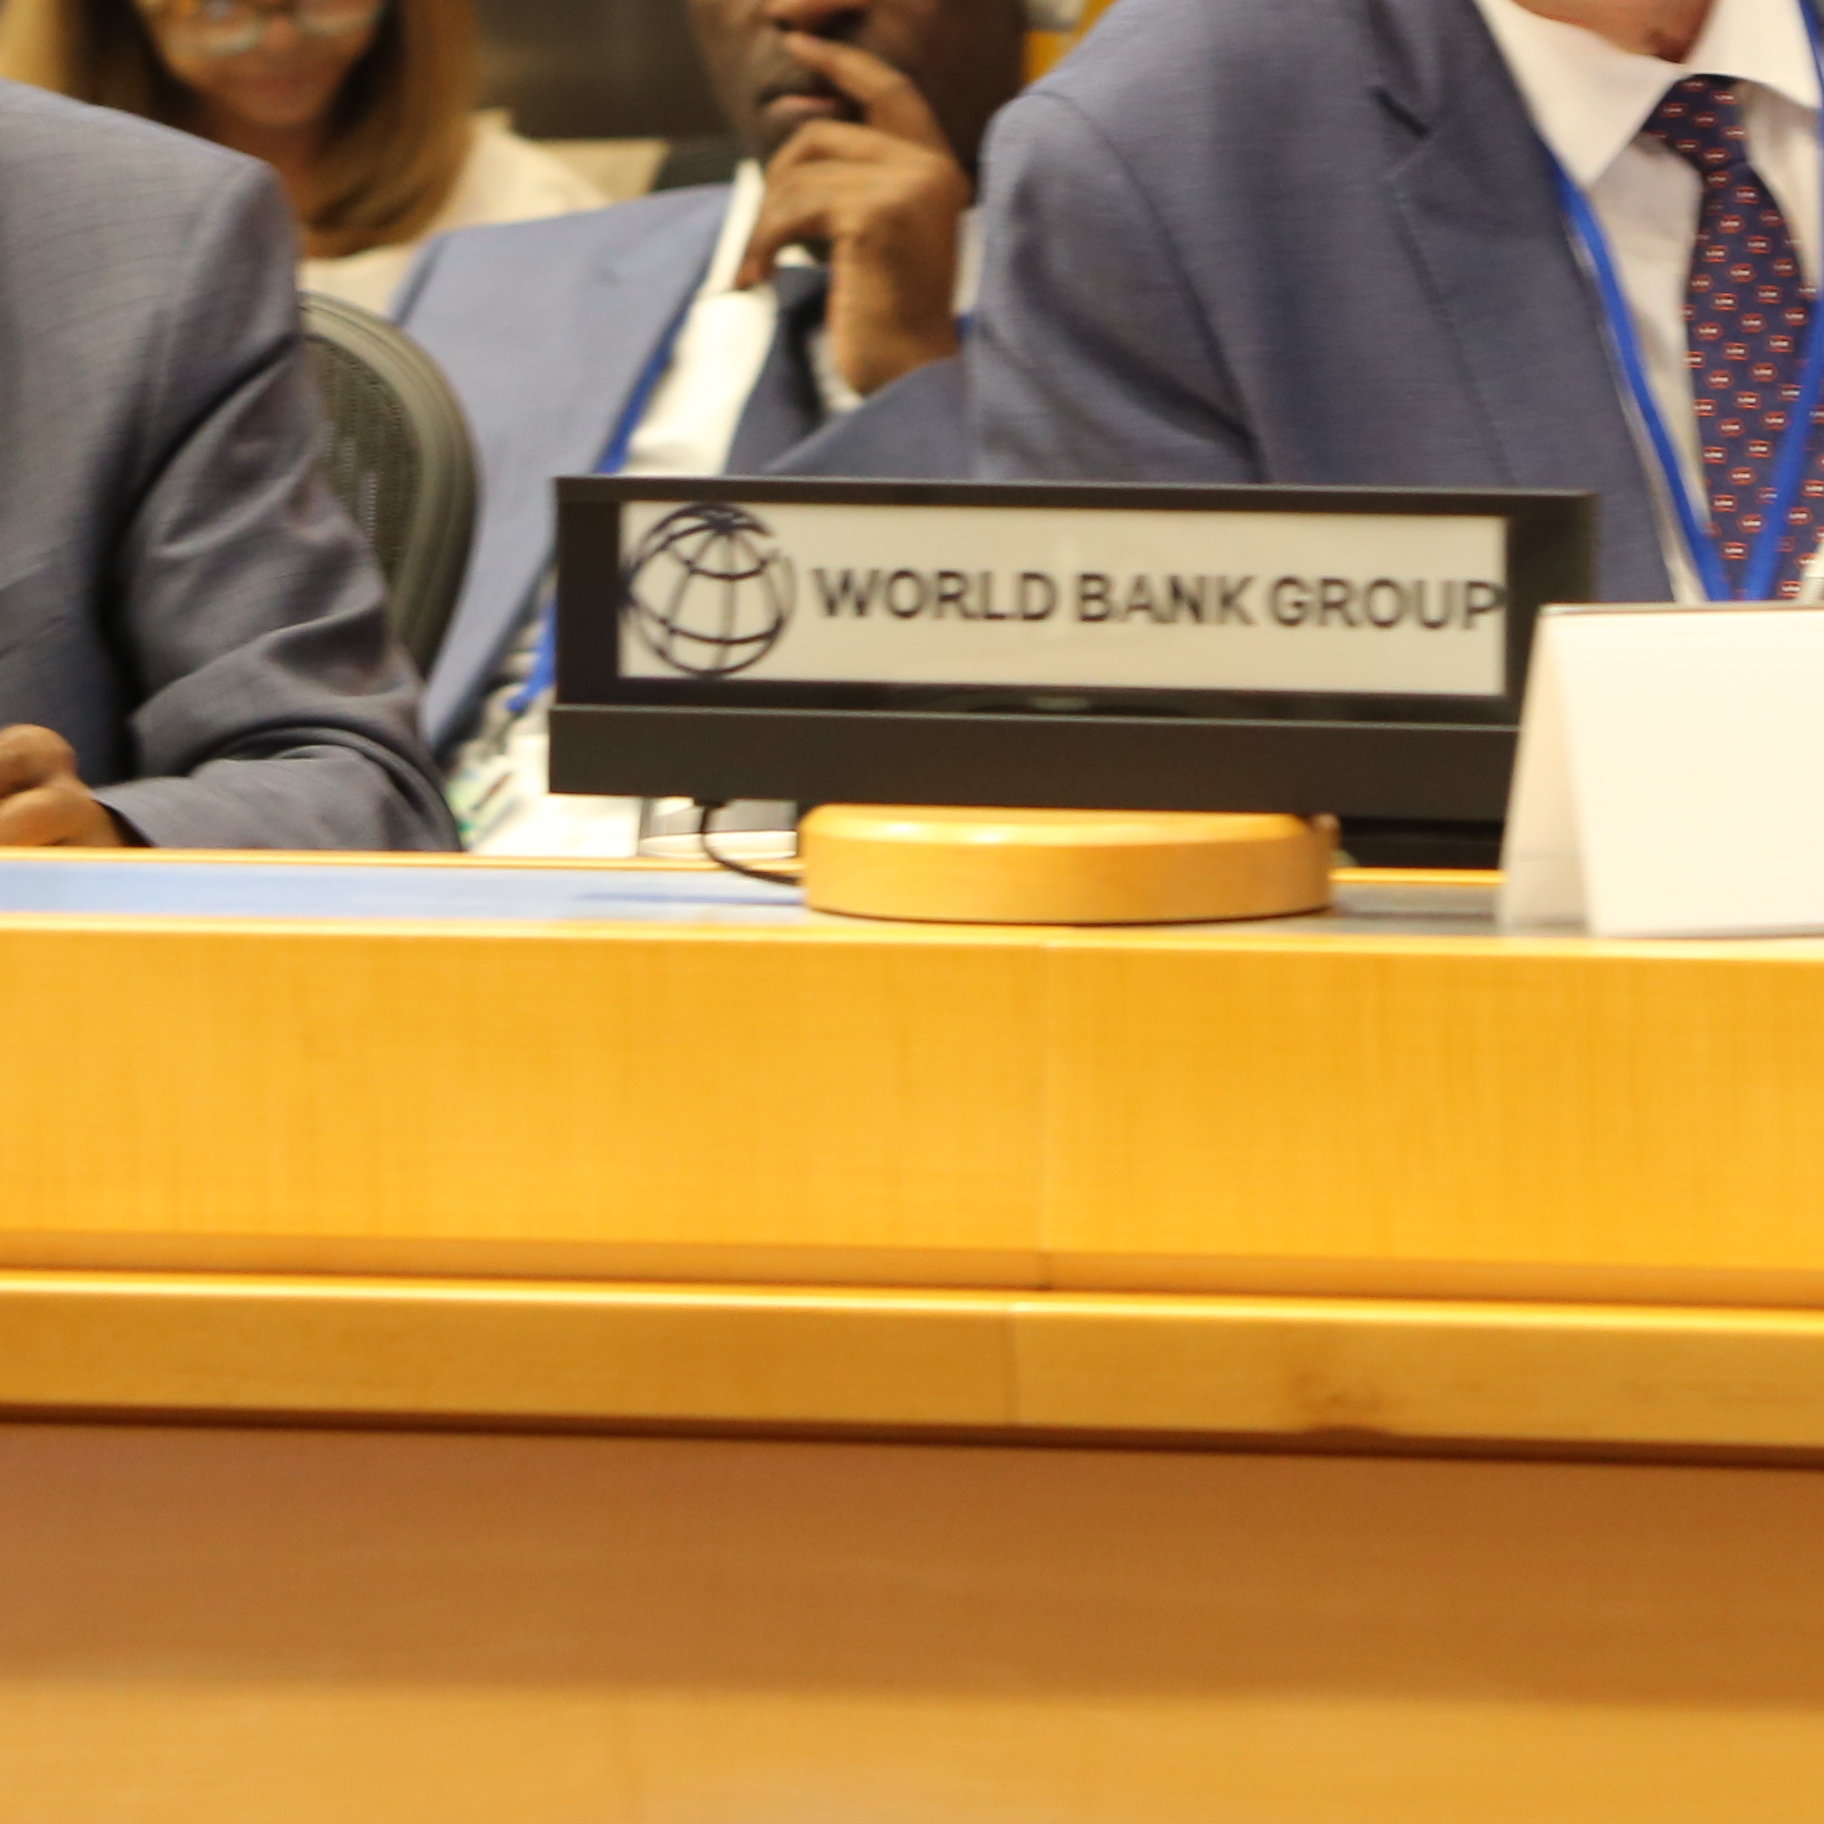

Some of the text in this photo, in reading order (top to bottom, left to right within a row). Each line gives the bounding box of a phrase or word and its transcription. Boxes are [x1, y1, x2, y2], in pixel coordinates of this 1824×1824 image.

[813, 570, 1506, 632] WORLD BANK GROUP
